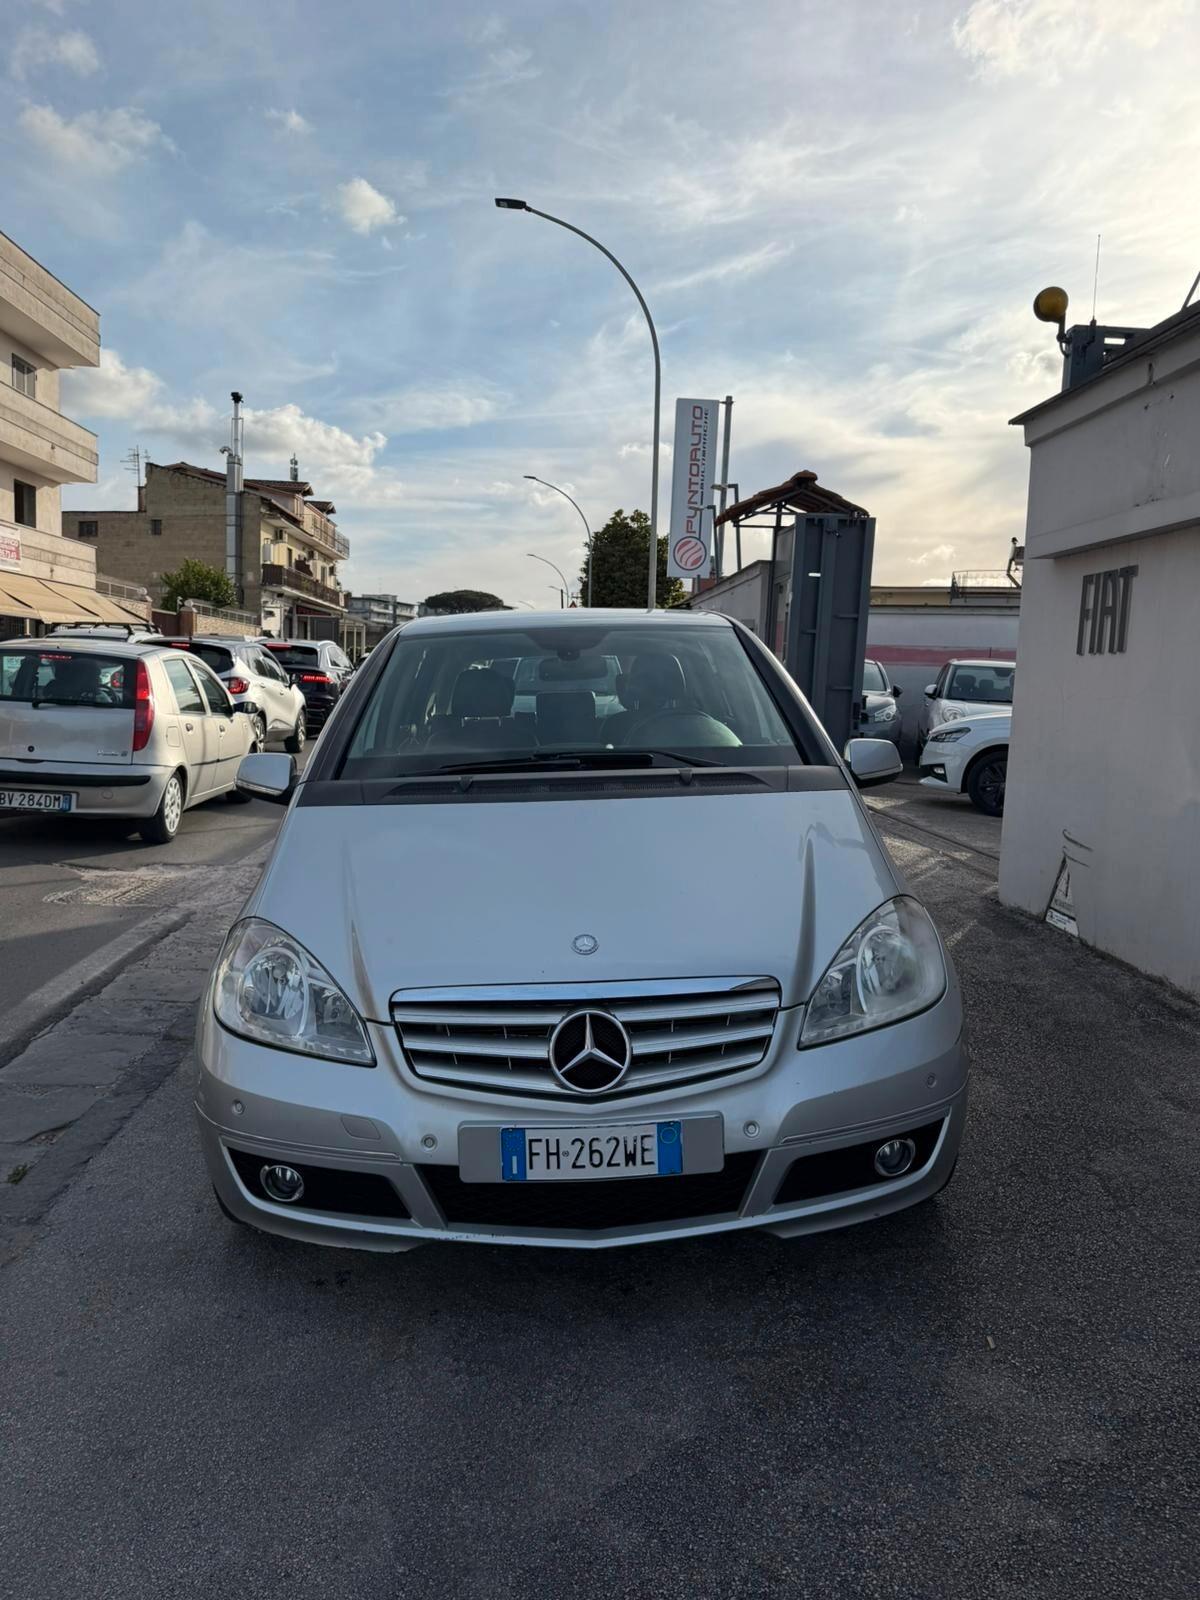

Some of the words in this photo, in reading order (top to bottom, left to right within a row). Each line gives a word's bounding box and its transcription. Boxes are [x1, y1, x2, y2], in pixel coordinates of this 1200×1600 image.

[1076, 564, 1139, 656] FIAT
[19, 793, 61, 808] 284DM
[528, 1138, 561, 1170] FH
[570, 1134, 655, 1169] 262WE
